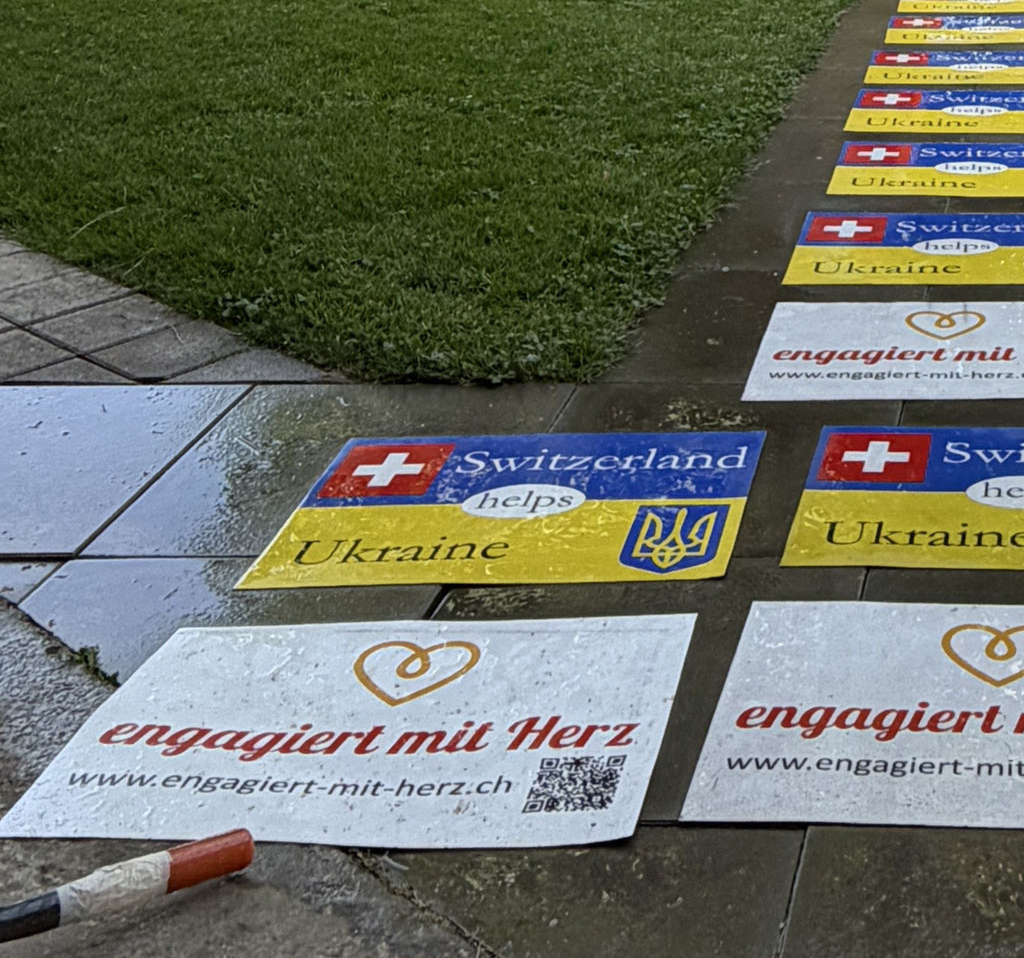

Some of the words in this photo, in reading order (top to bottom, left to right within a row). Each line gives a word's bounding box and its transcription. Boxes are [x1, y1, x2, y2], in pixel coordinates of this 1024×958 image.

[867, 117, 979, 128] Ukraine
[944, 163, 1001, 173] helps
[851, 177, 977, 188] Ukraine
[924, 242, 991, 253] helps
[813, 261, 962, 275] Ukraine
[772, 345, 948, 365] engagiert
[952, 345, 1017, 362] mit
[454, 446, 748, 475] Switzerland
[476, 489, 574, 514] helps
[293, 536, 510, 567] Ukraine
[736, 702, 1005, 742] engagiert
[99, 716, 386, 762] engagiert
[388, 719, 494, 756] mit
[502, 714, 640, 752] Herz
[67, 770, 512, 798] www.engagiert-mit-herz.ch
